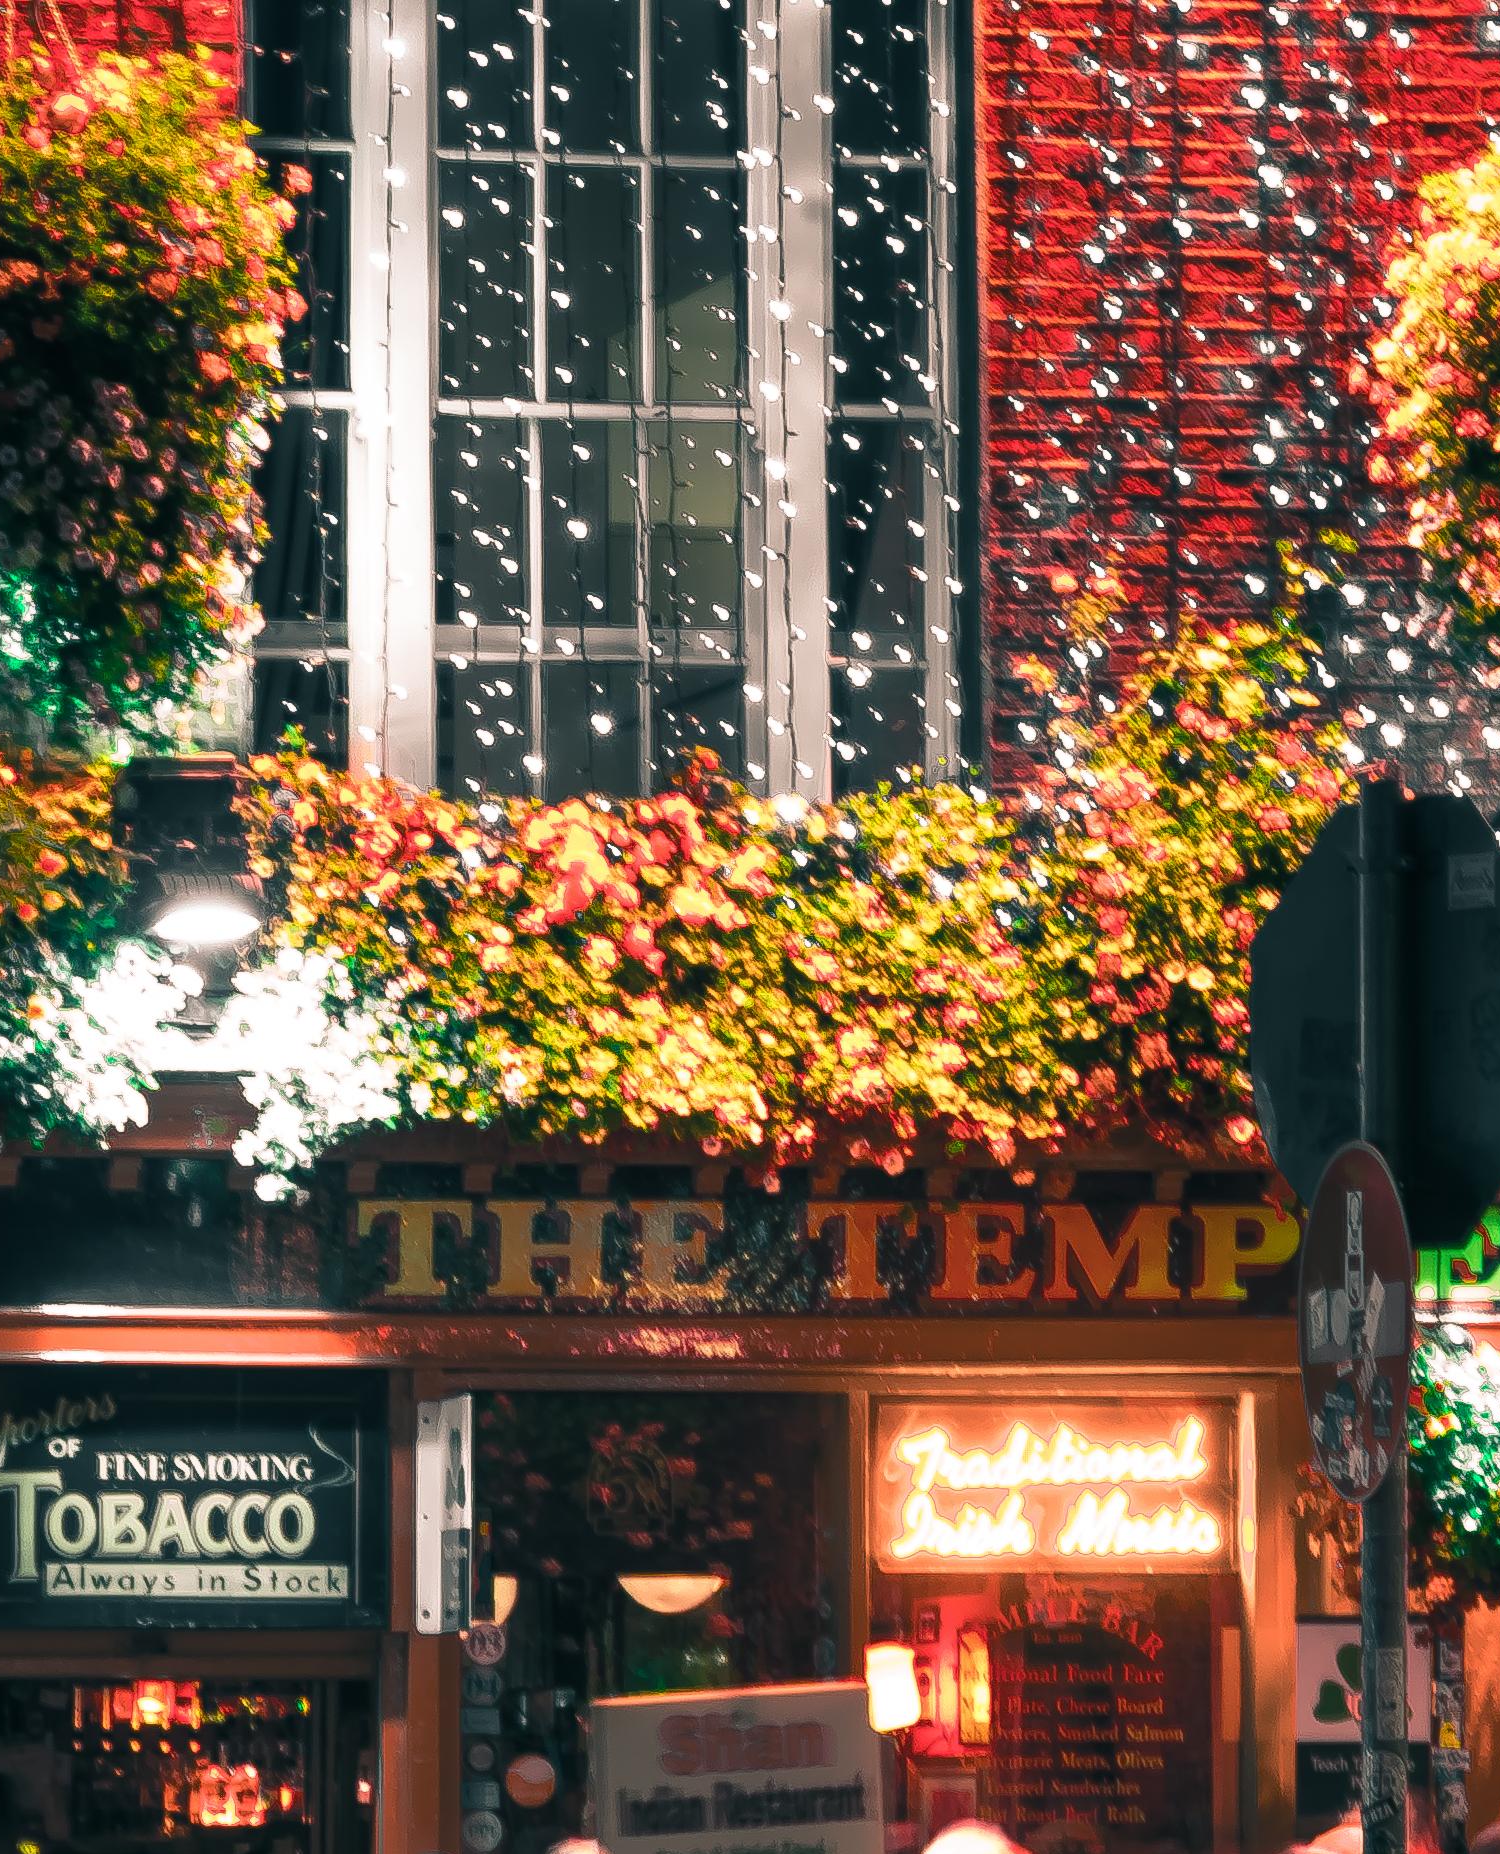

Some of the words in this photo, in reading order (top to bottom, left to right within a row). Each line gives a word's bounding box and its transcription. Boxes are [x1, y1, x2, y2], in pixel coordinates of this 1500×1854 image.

[358, 1200, 727, 1299] THE
[47, 1436, 84, 1460] OF
[895, 1415, 1209, 1491] Traditional
[97, 1452, 168, 1482] FINE
[171, 1452, 315, 1483] SMOKING
[891, 1487, 1037, 1560] Irish
[1056, 1486, 1222, 1557] Music
[51, 1567, 177, 1598] Always
[197, 1567, 226, 1592] in
[242, 1566, 343, 1593] Stock
[1116, 1696, 1164, 1714] Board
[659, 1711, 831, 1776] Shan
[1125, 1724, 1185, 1743] Salmon
[1115, 1751, 1165, 1769] Olives
[712, 1770, 866, 1830] Restaurant
